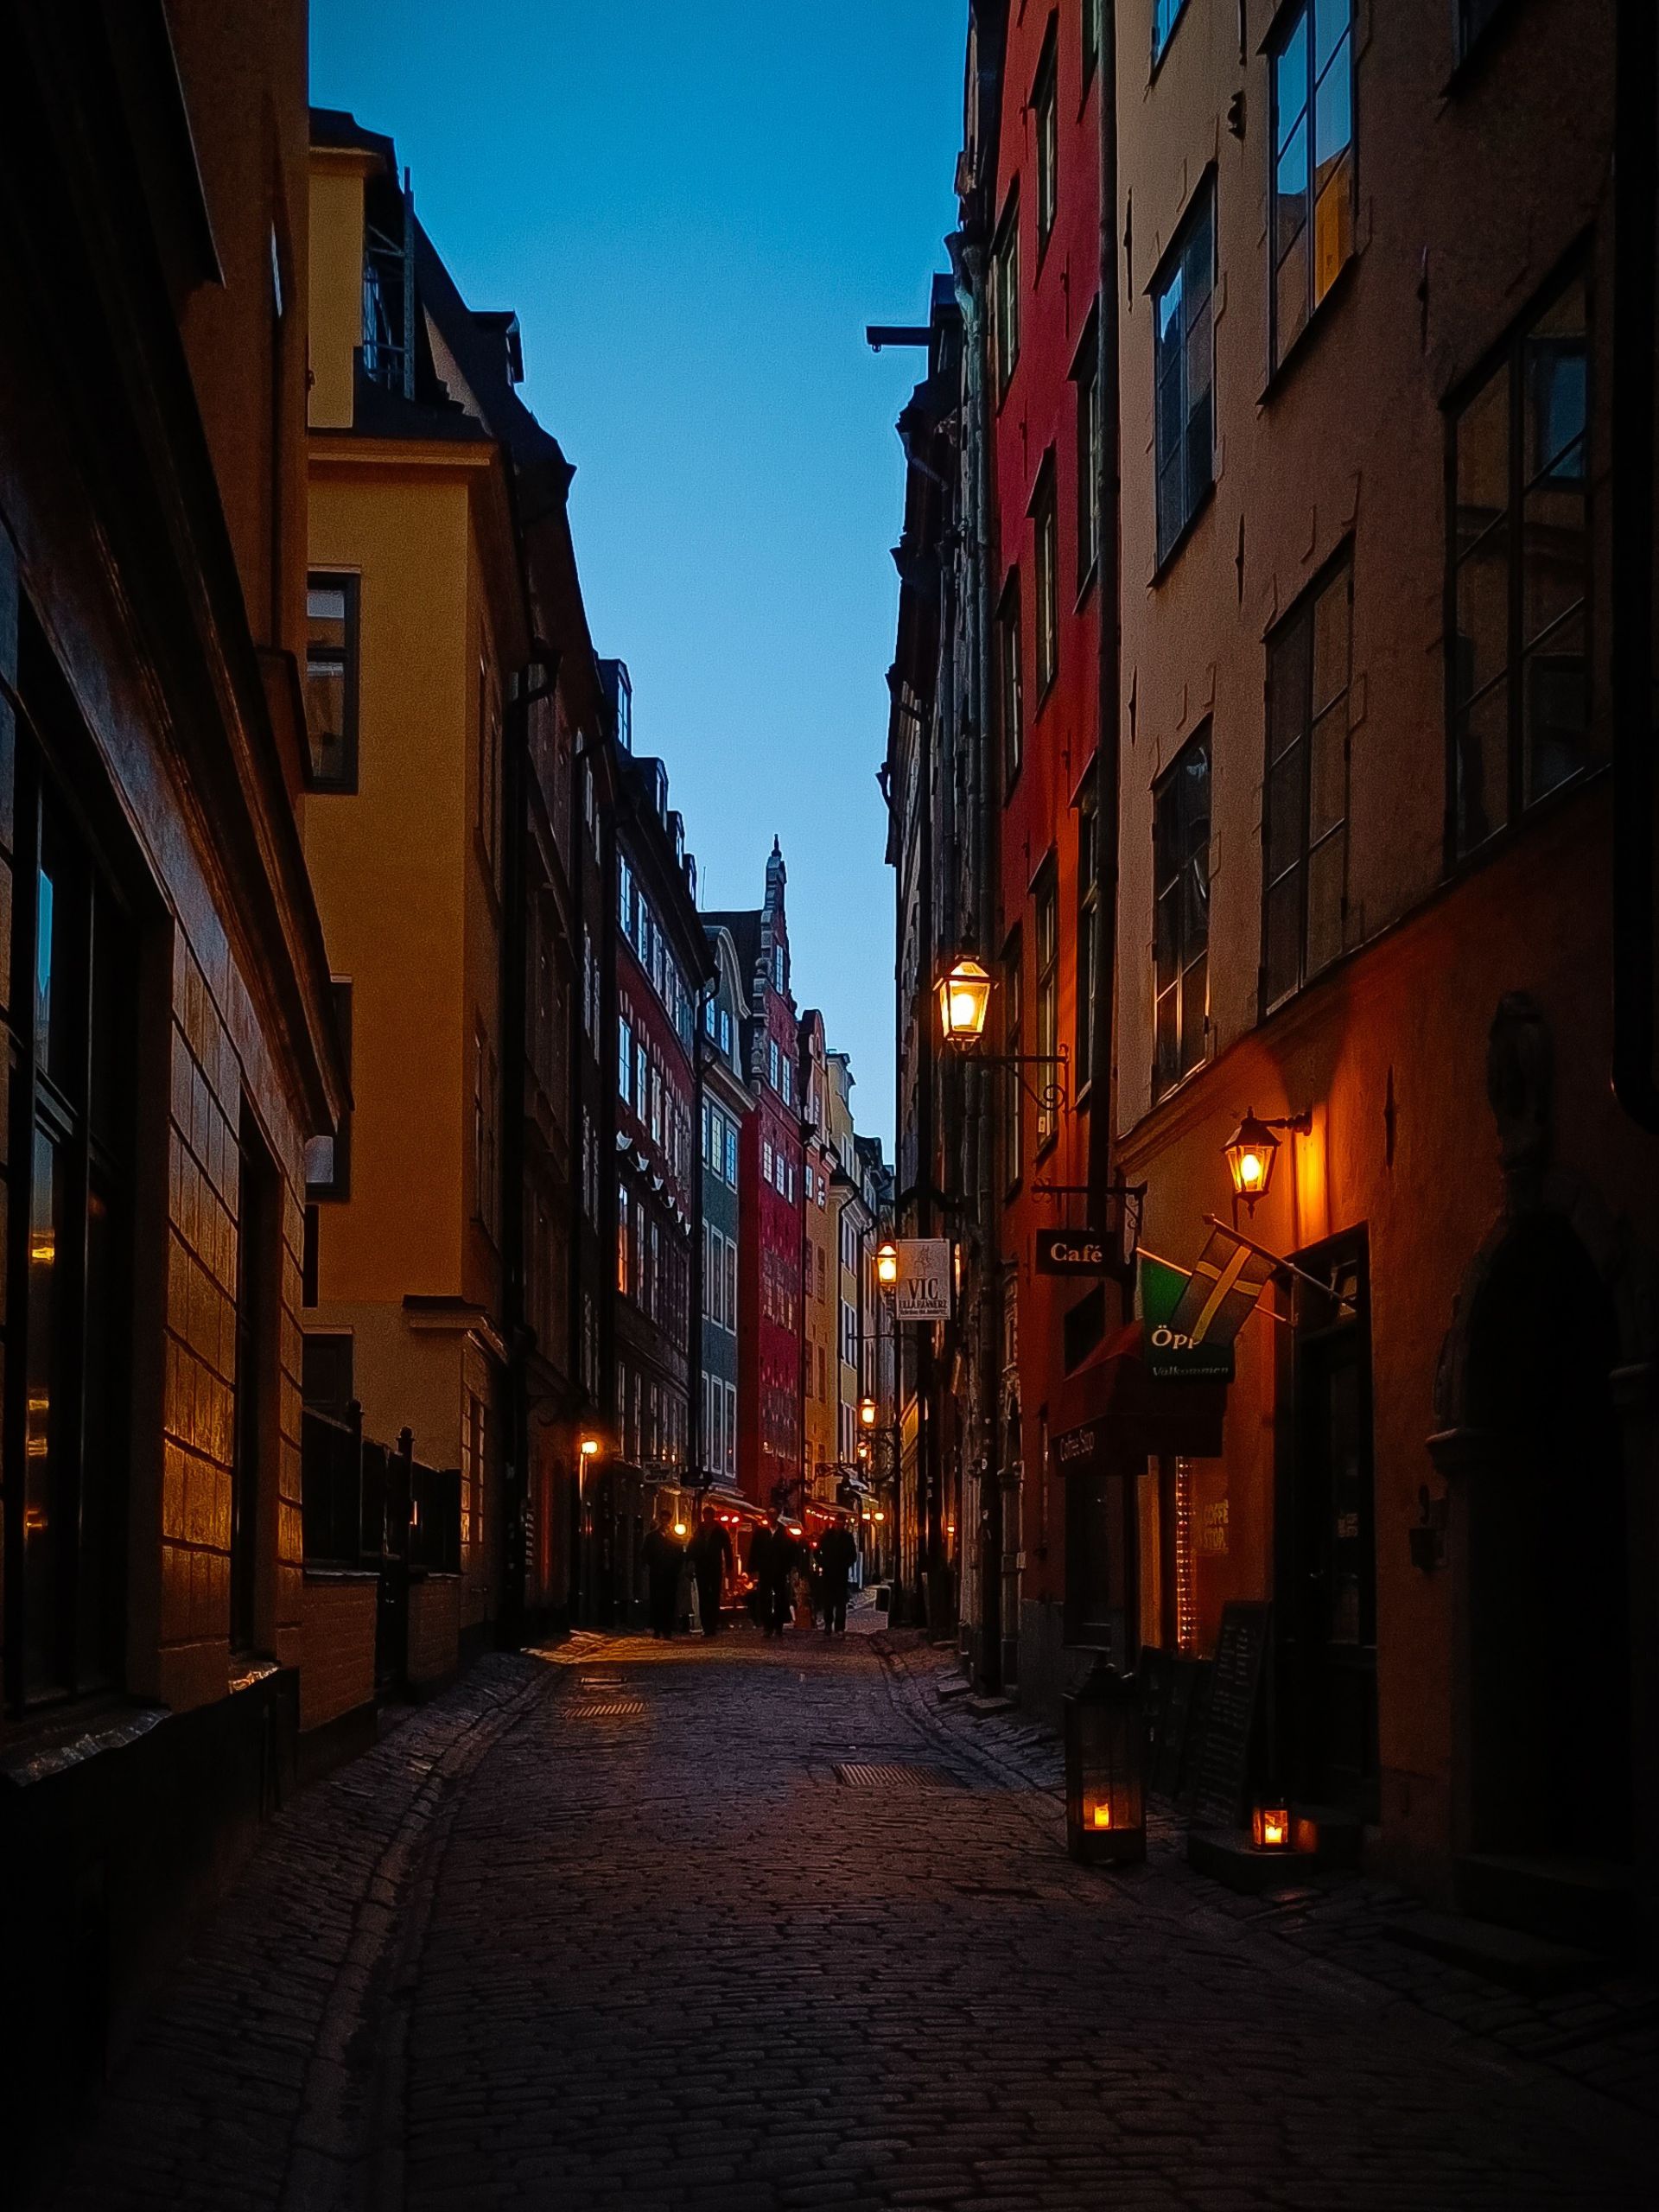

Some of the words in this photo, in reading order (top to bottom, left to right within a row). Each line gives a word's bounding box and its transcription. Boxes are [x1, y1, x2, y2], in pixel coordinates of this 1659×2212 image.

[1049, 1242, 1103, 1262] Café
[907, 1278, 939, 1300] VIC
[1151, 1323, 1203, 1349] Öpp
